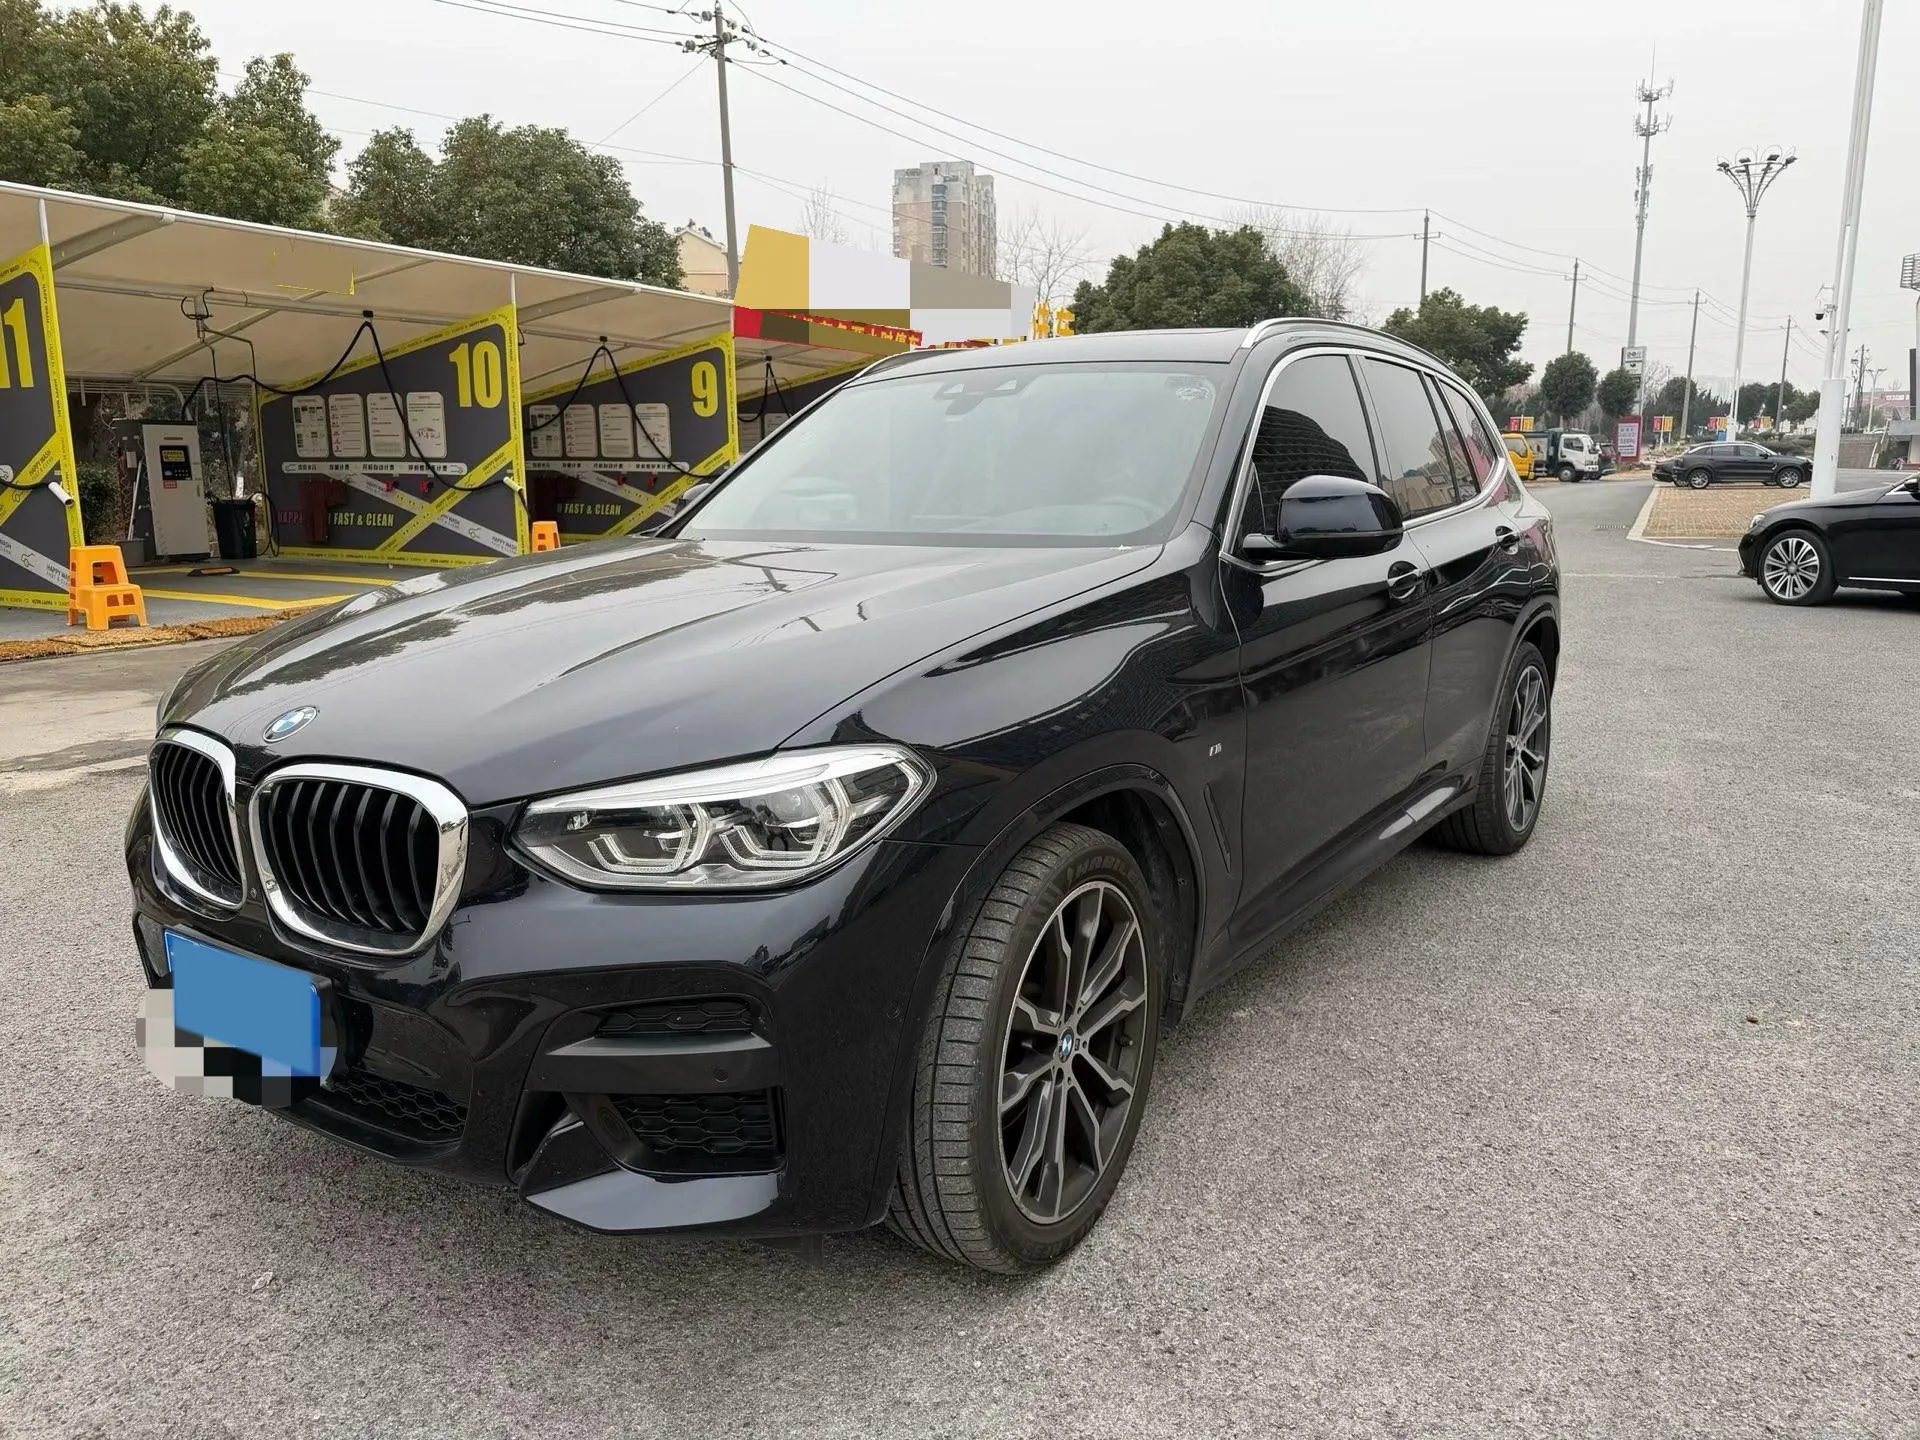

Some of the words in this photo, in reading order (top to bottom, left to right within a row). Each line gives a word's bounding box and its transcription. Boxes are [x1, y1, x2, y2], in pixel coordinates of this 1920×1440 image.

[449, 340, 502, 409] 10
[691, 361, 719, 417] 9
[333, 512, 355, 526] FAST
[356, 515, 363, 526] &
[365, 512, 394, 527] CLEAN
[564, 503, 585, 515] FAST
[586, 505, 594, 515] &
[595, 504, 622, 516] CLEAN
